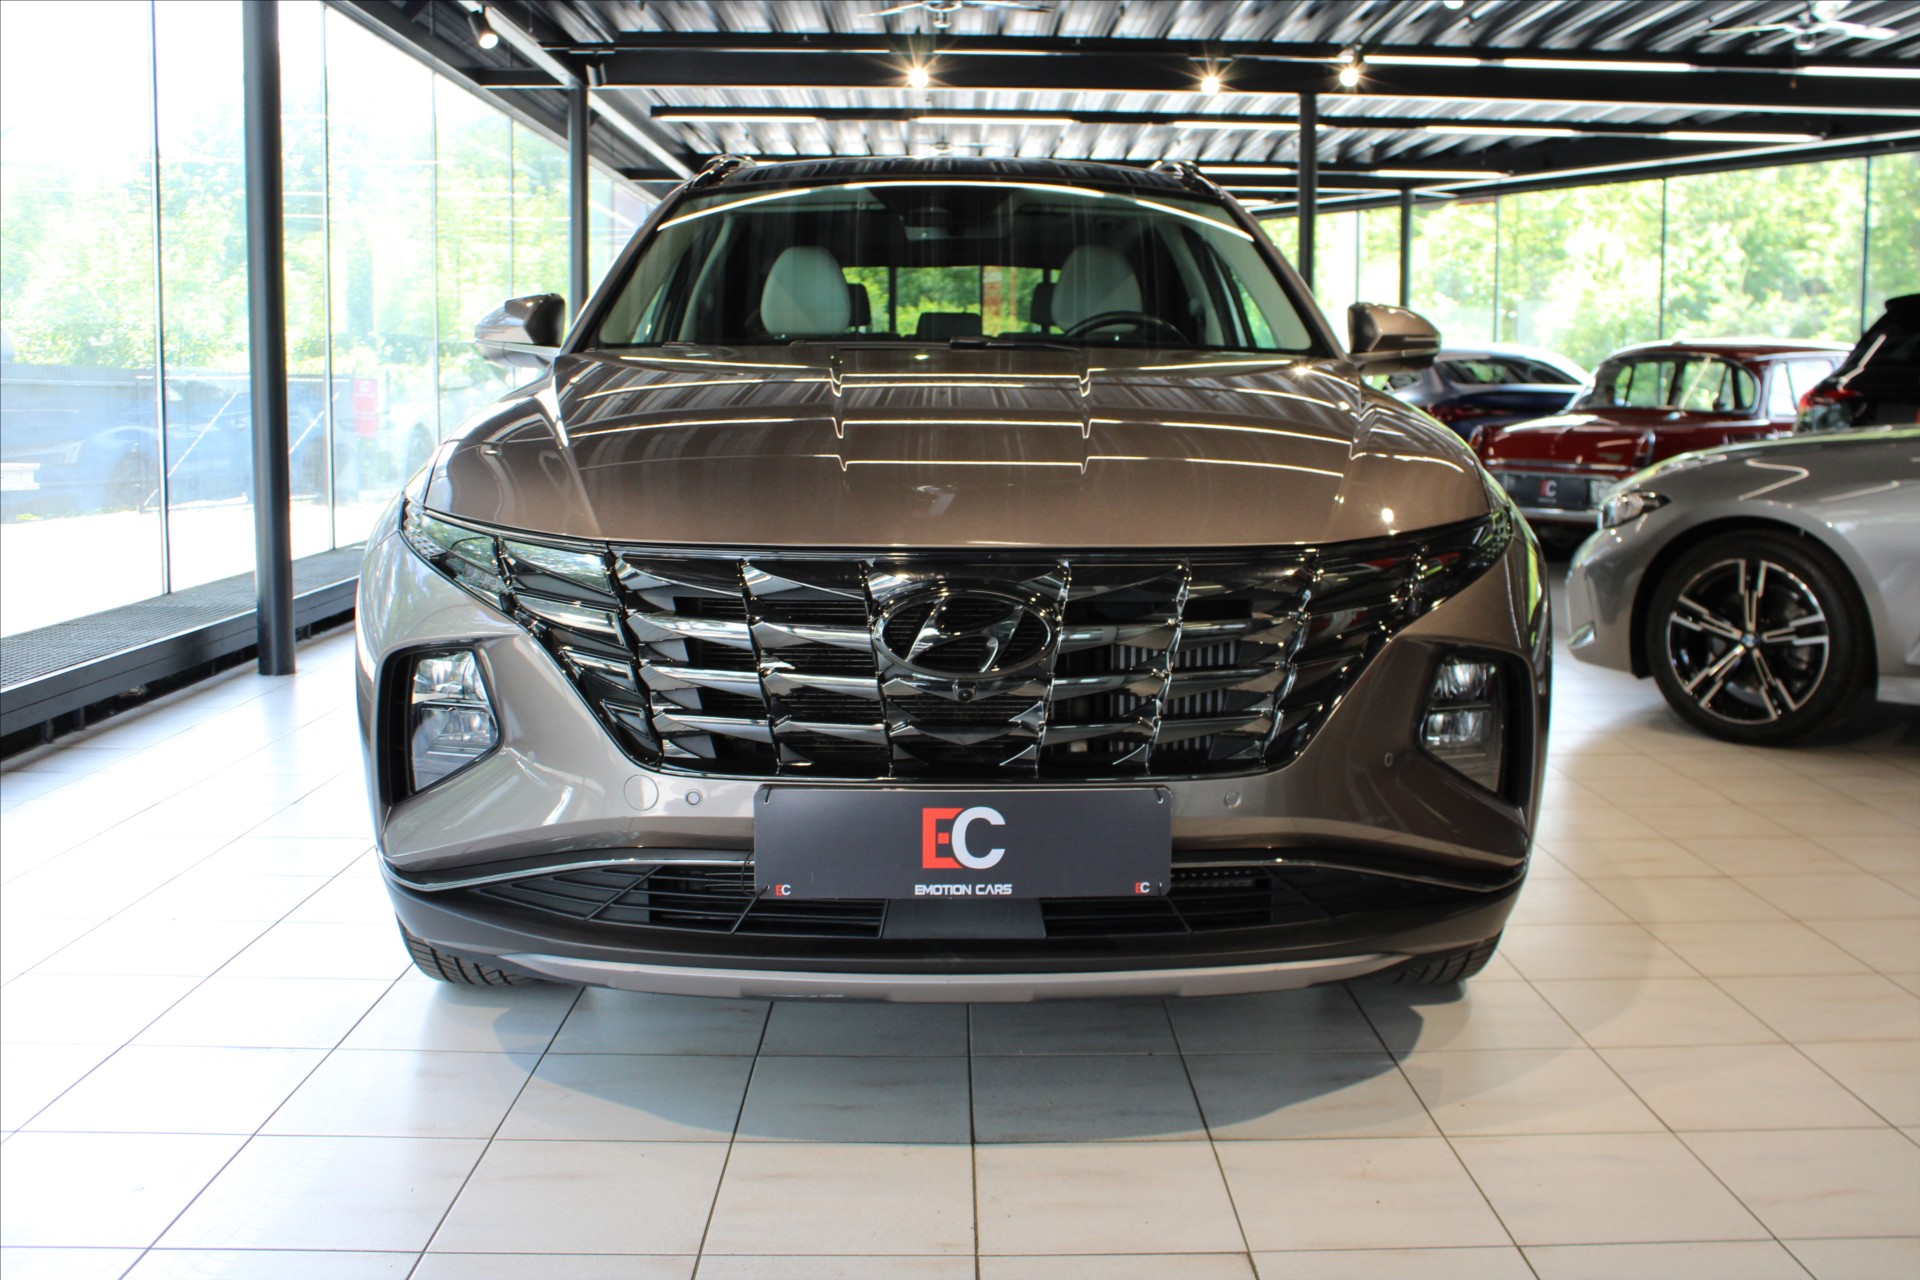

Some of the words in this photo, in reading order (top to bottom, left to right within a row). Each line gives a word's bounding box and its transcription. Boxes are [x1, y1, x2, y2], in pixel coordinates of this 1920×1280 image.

[922, 806, 1006, 870] EC
[775, 884, 791, 896] EC
[914, 884, 972, 896] EMOTION
[975, 884, 1013, 896] CARS
[1135, 882, 1150, 894] EC
